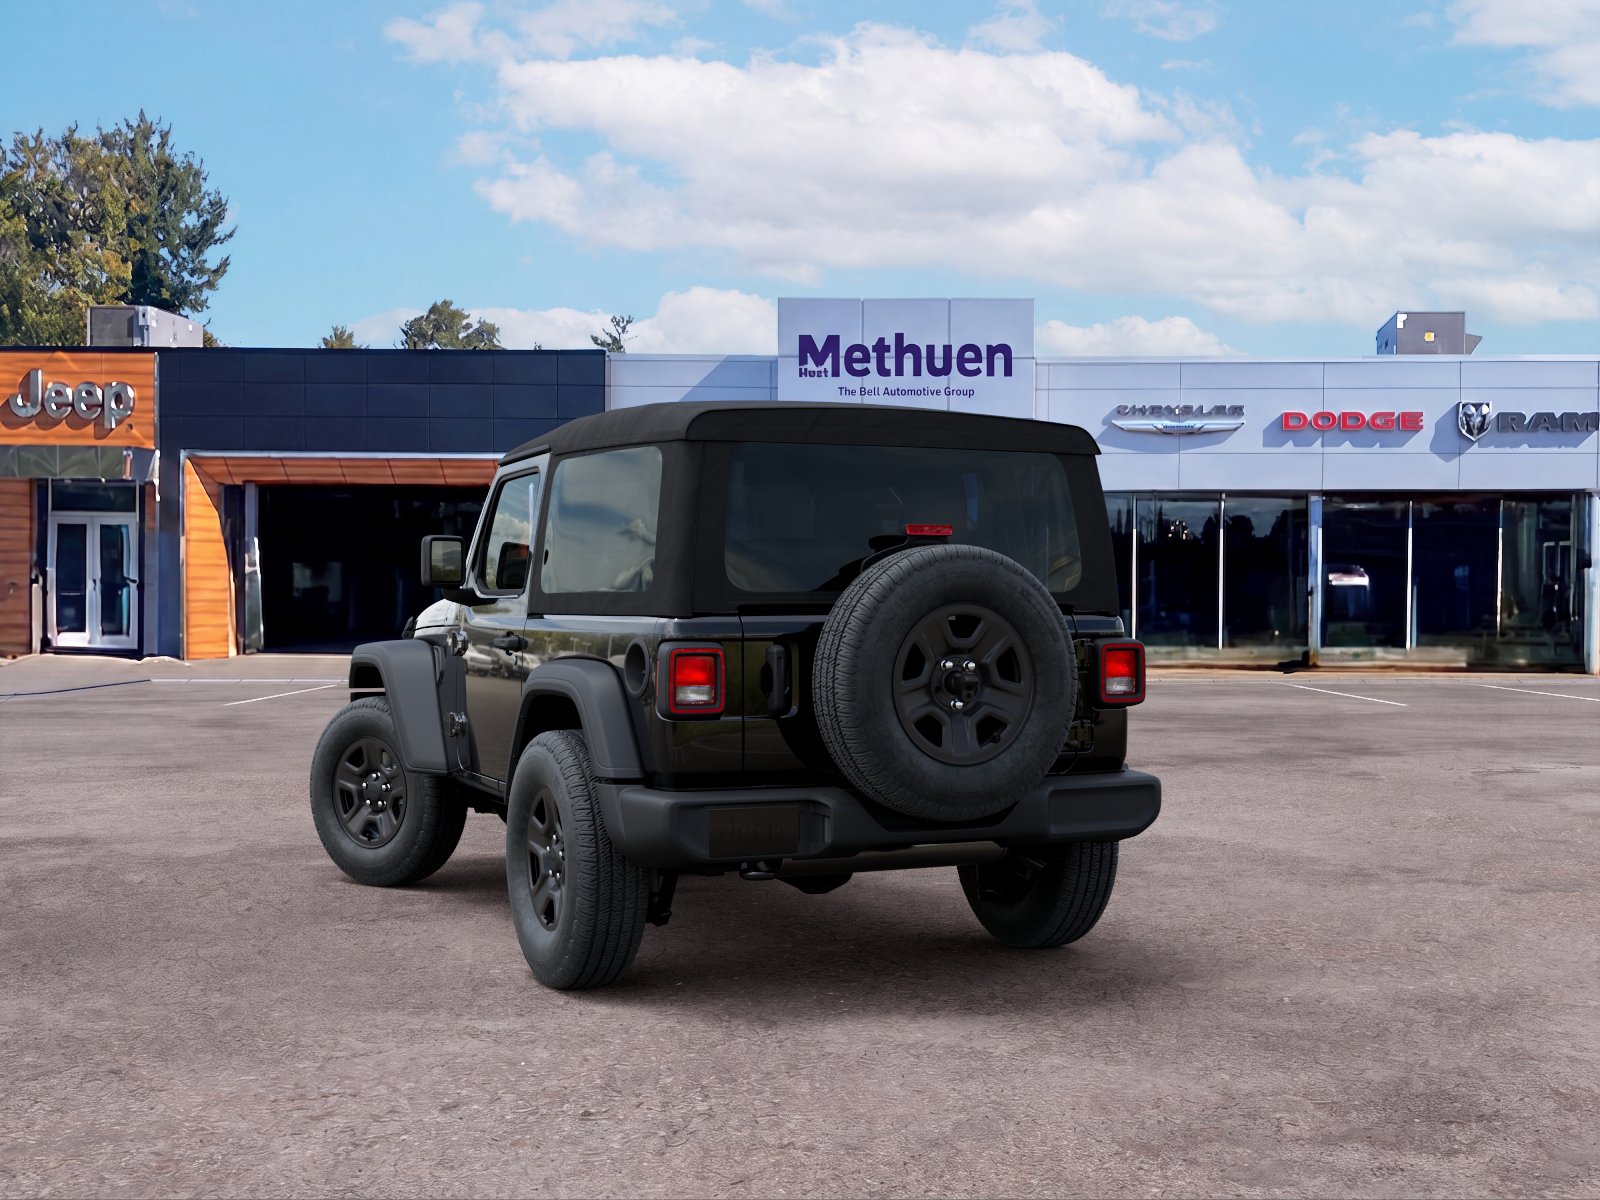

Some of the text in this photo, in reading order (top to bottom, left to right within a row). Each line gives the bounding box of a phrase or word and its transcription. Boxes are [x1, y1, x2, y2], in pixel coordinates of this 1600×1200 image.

[798, 332, 1013, 377] Methuen
[9, 368, 136, 429] Jeep
[838, 386, 975, 399] The Bell Automotive Group
[1282, 411, 1424, 431] DODGE
[1497, 411, 1600, 433] RAM
